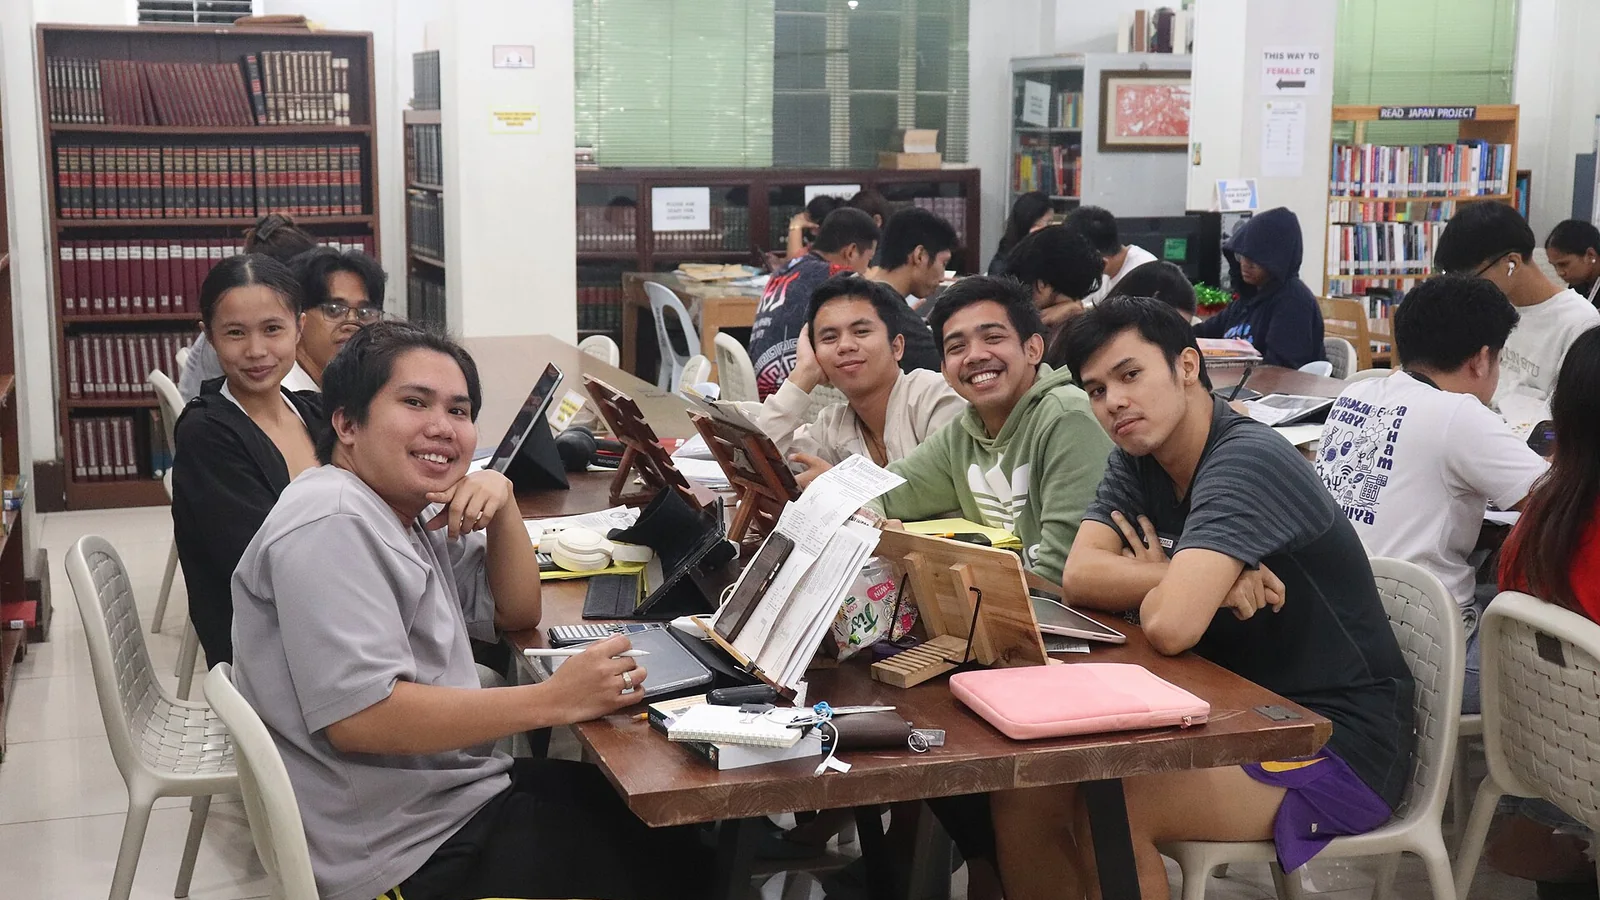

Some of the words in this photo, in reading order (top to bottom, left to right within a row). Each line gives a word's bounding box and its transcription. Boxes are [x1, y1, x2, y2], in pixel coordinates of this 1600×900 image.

[1264, 52, 1284, 60] THIS
[1287, 52, 1305, 60] WAY
[1308, 52, 1319, 60] TO
[1266, 67, 1301, 75] FEMALE
[1303, 67, 1315, 75] CR
[1381, 108, 1404, 118] READ
[1408, 107, 1435, 118] JAPAN
[1437, 107, 1475, 118] PROJECT
